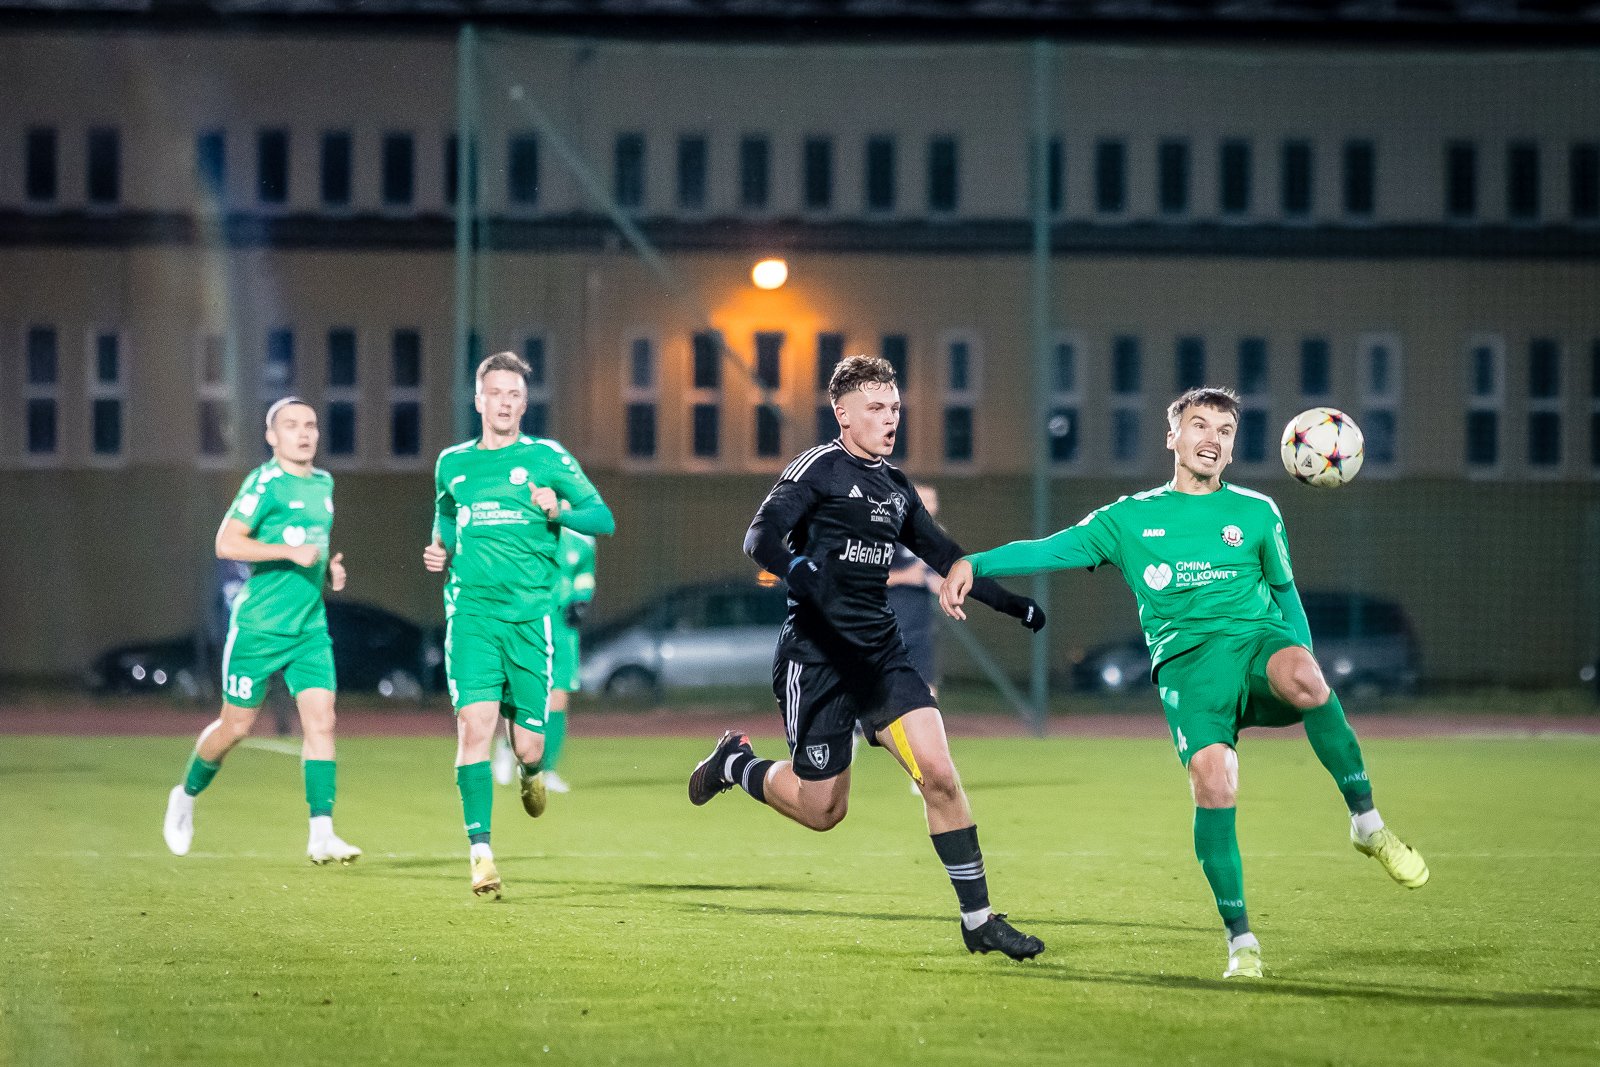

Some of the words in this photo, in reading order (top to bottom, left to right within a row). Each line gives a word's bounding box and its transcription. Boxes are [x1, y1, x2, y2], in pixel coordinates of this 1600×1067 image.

[1142, 528, 1166, 538] JAKO
[838, 538, 882, 565] Jelenia
[1175, 561, 1212, 572] GMINA
[227, 673, 254, 700] 18
[1342, 770, 1368, 785] JAKO
